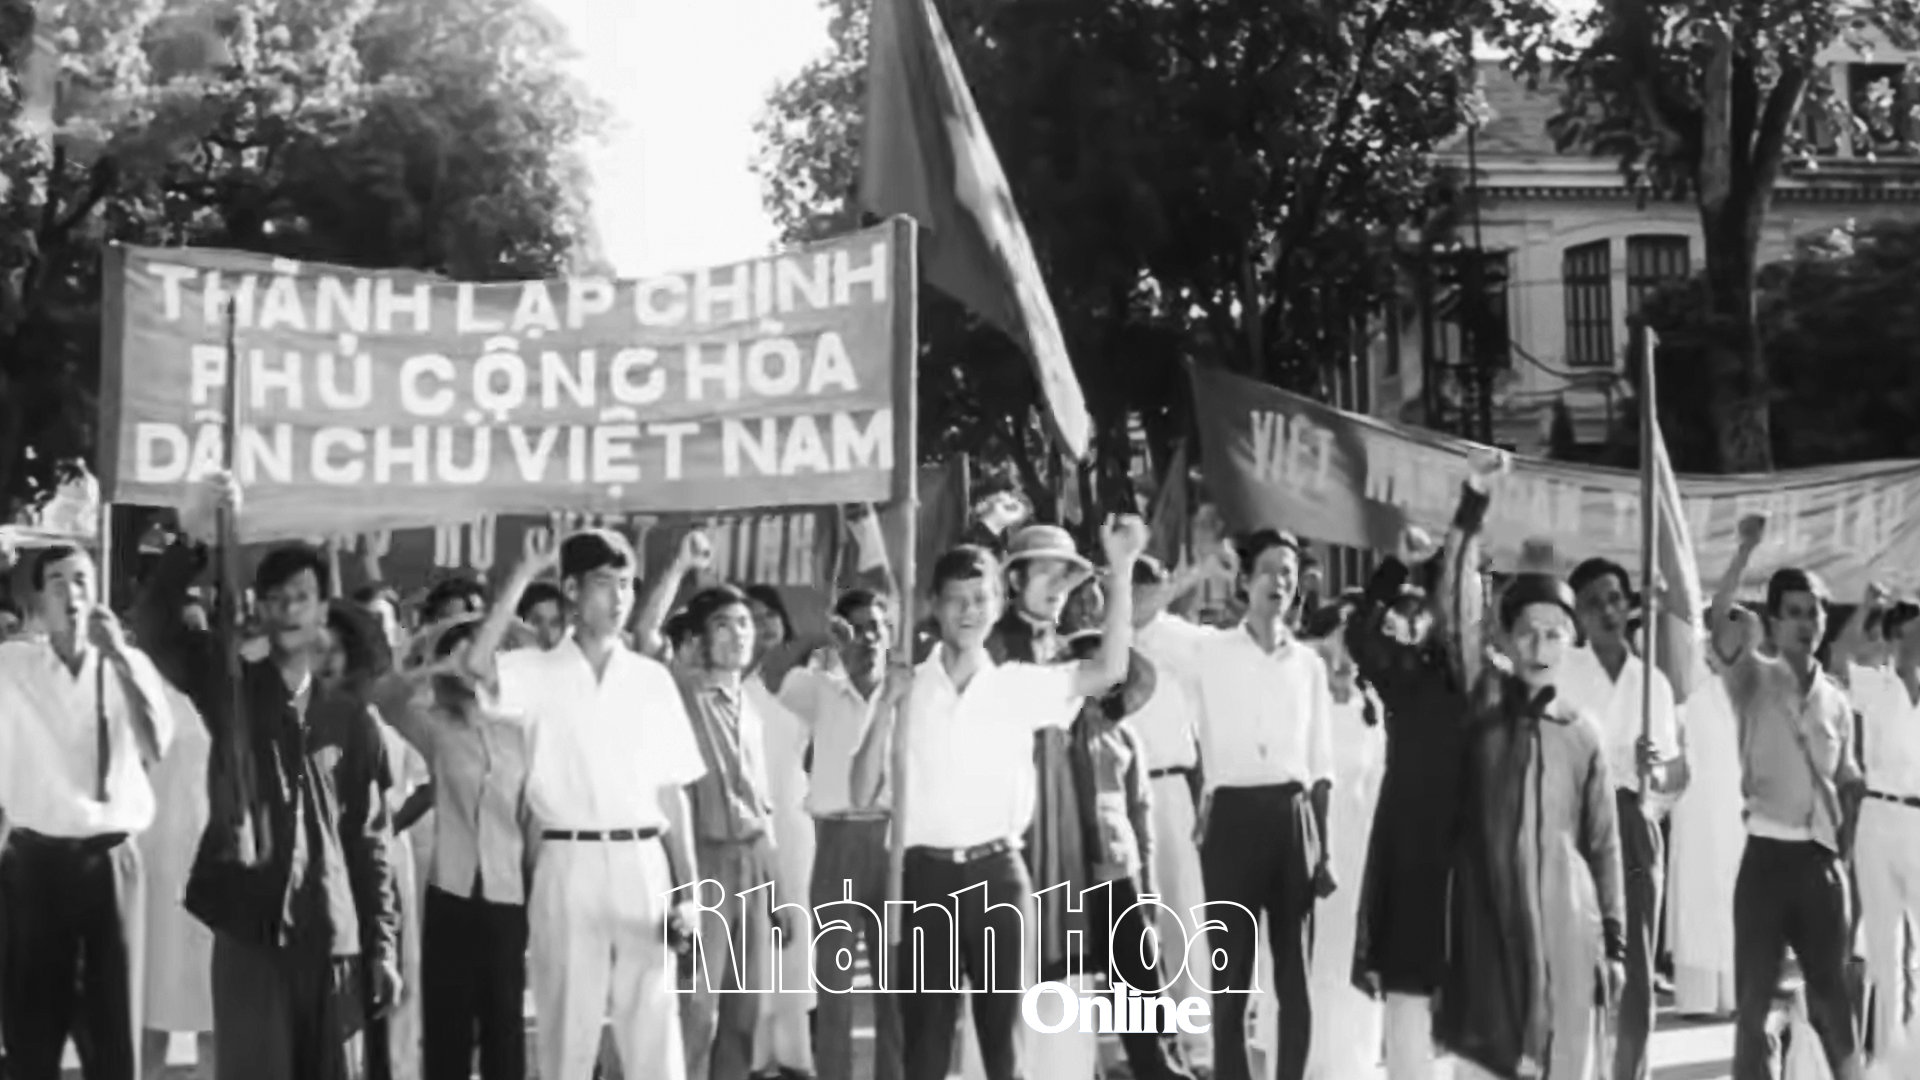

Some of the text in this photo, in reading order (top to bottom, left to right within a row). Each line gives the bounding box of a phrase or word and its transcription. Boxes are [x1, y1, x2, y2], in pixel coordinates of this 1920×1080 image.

[399, 336, 666, 421] CỘNG
[137, 410, 293, 485] DÂN
[507, 405, 699, 497] VIỆT
[722, 408, 893, 478] NAM
